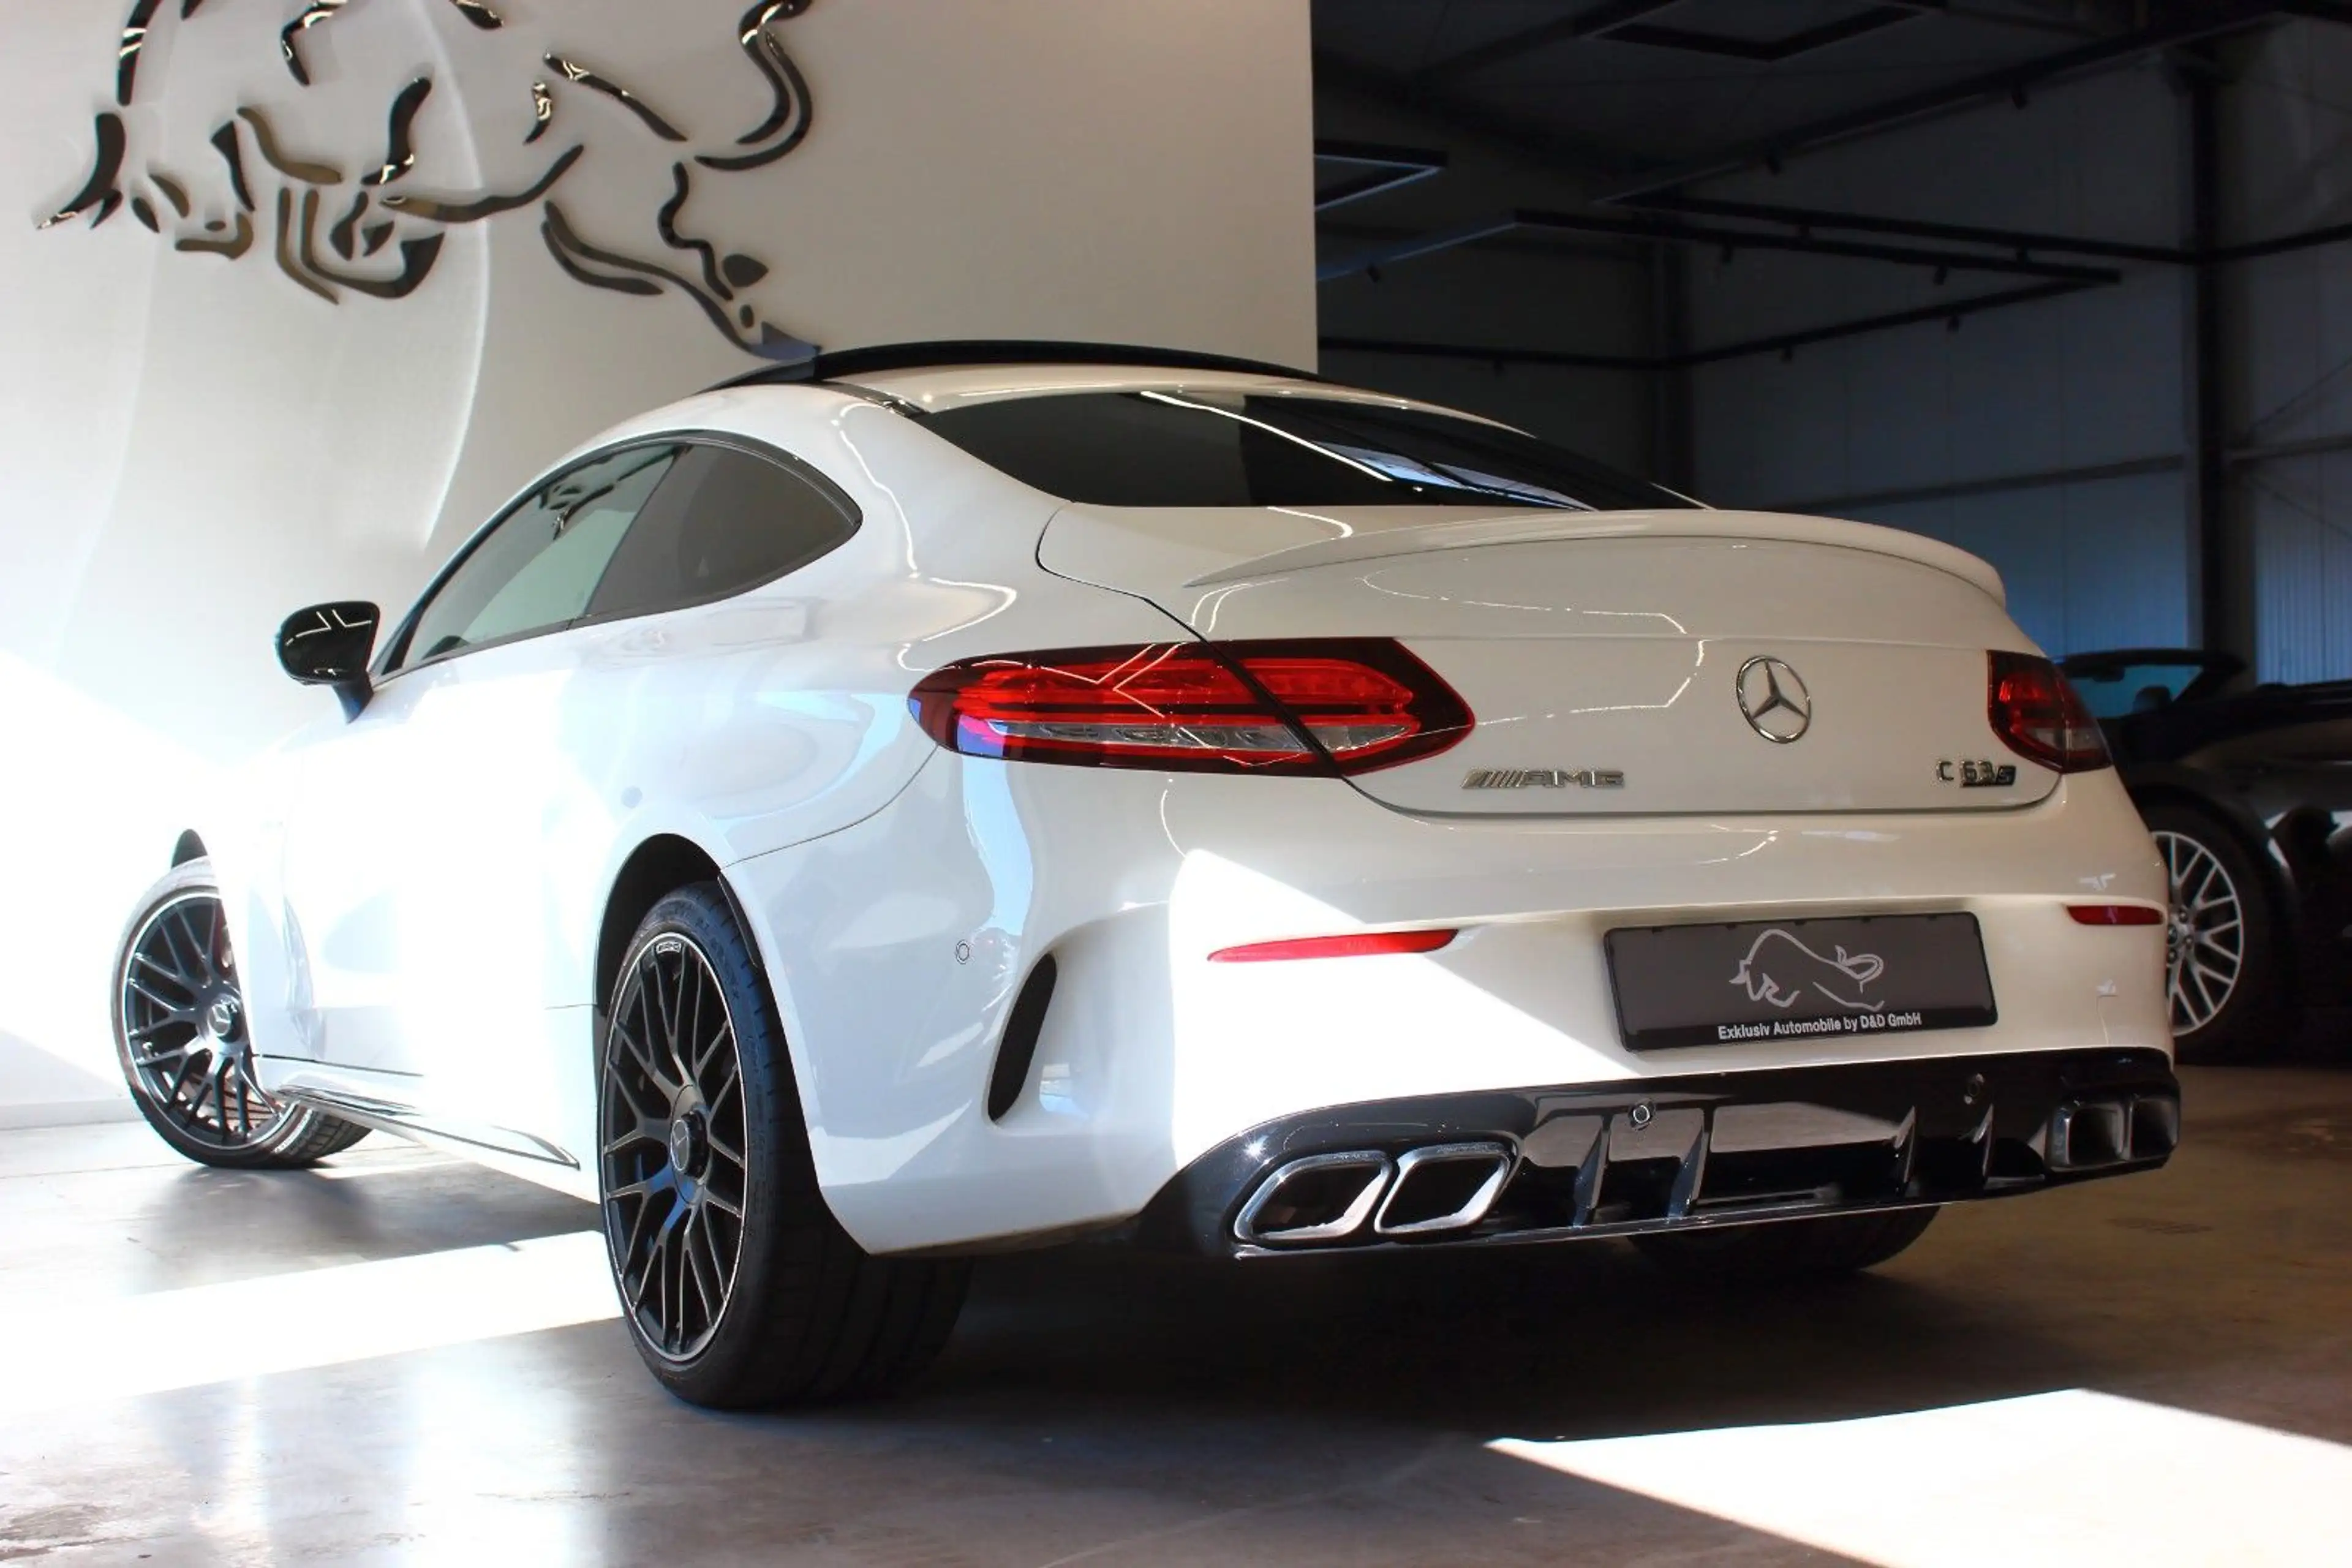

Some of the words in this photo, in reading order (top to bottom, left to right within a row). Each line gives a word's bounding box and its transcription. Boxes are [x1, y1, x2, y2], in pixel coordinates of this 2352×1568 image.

[1521, 768, 1625, 788] AMG
[1936, 761, 1954, 781] C
[1717, 1022, 1770, 1040] Exklusiv
[1774, 1017, 1841, 1035] Automobile
[1843, 1017, 1858, 1033] by
[1860, 1014, 1885, 1028] D&D
[1887, 1012, 1922, 1027] GmbH
